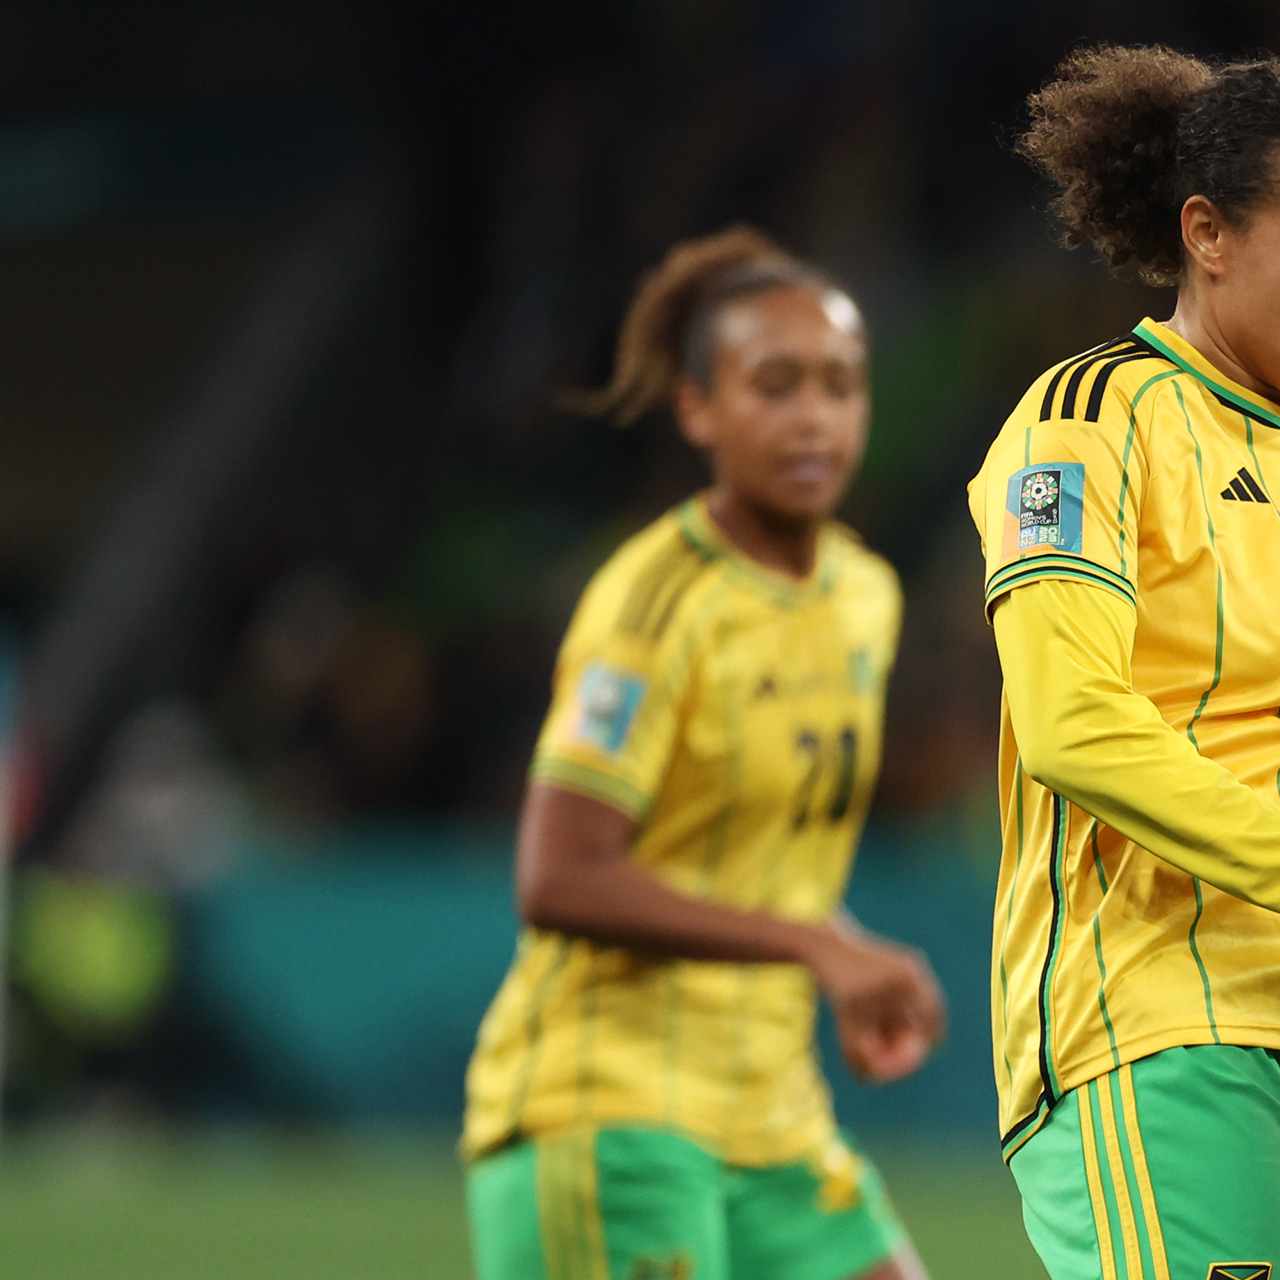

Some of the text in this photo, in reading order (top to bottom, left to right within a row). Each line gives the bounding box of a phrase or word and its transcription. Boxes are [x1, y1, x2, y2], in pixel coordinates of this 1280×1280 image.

[1020, 511, 1034, 519] FIFA
[1020, 528, 1036, 540] AU
[1020, 535, 1036, 547] NZ
